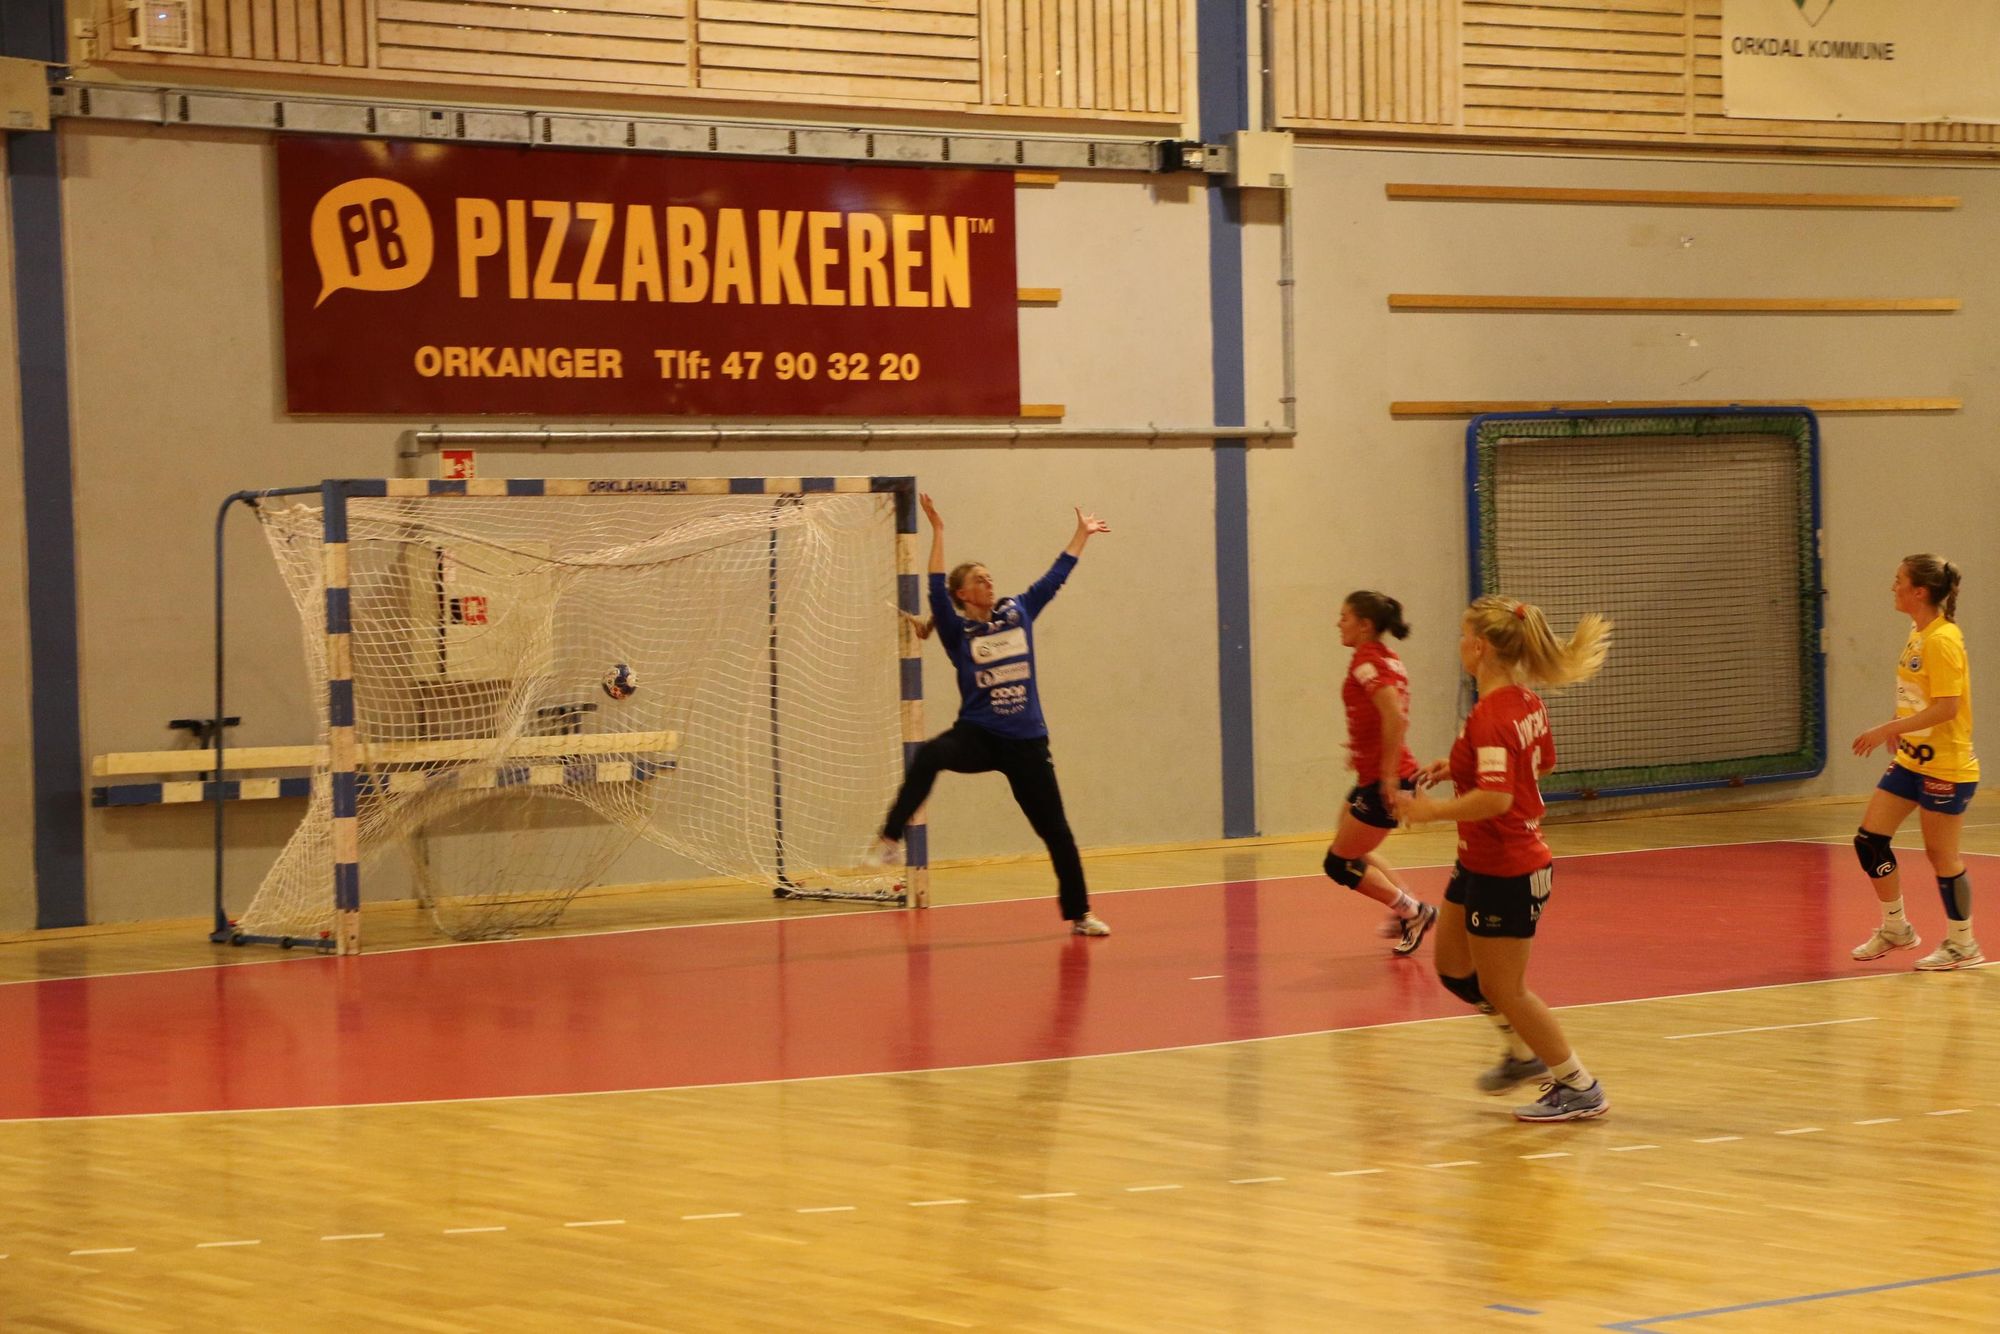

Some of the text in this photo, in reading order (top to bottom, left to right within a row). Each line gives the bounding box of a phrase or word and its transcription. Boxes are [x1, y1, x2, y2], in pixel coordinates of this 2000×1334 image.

[1731, 36, 1895, 61] ORKDAL KOMMUNE
[338, 197, 406, 277] PB
[456, 198, 972, 308] PIZZABAKEREN
[414, 346, 921, 381] ORKANGER Tlf: 47 90 32 20
[588, 480, 688, 493] ORKLAHALLEN
[1471, 911, 1480, 928] 6
